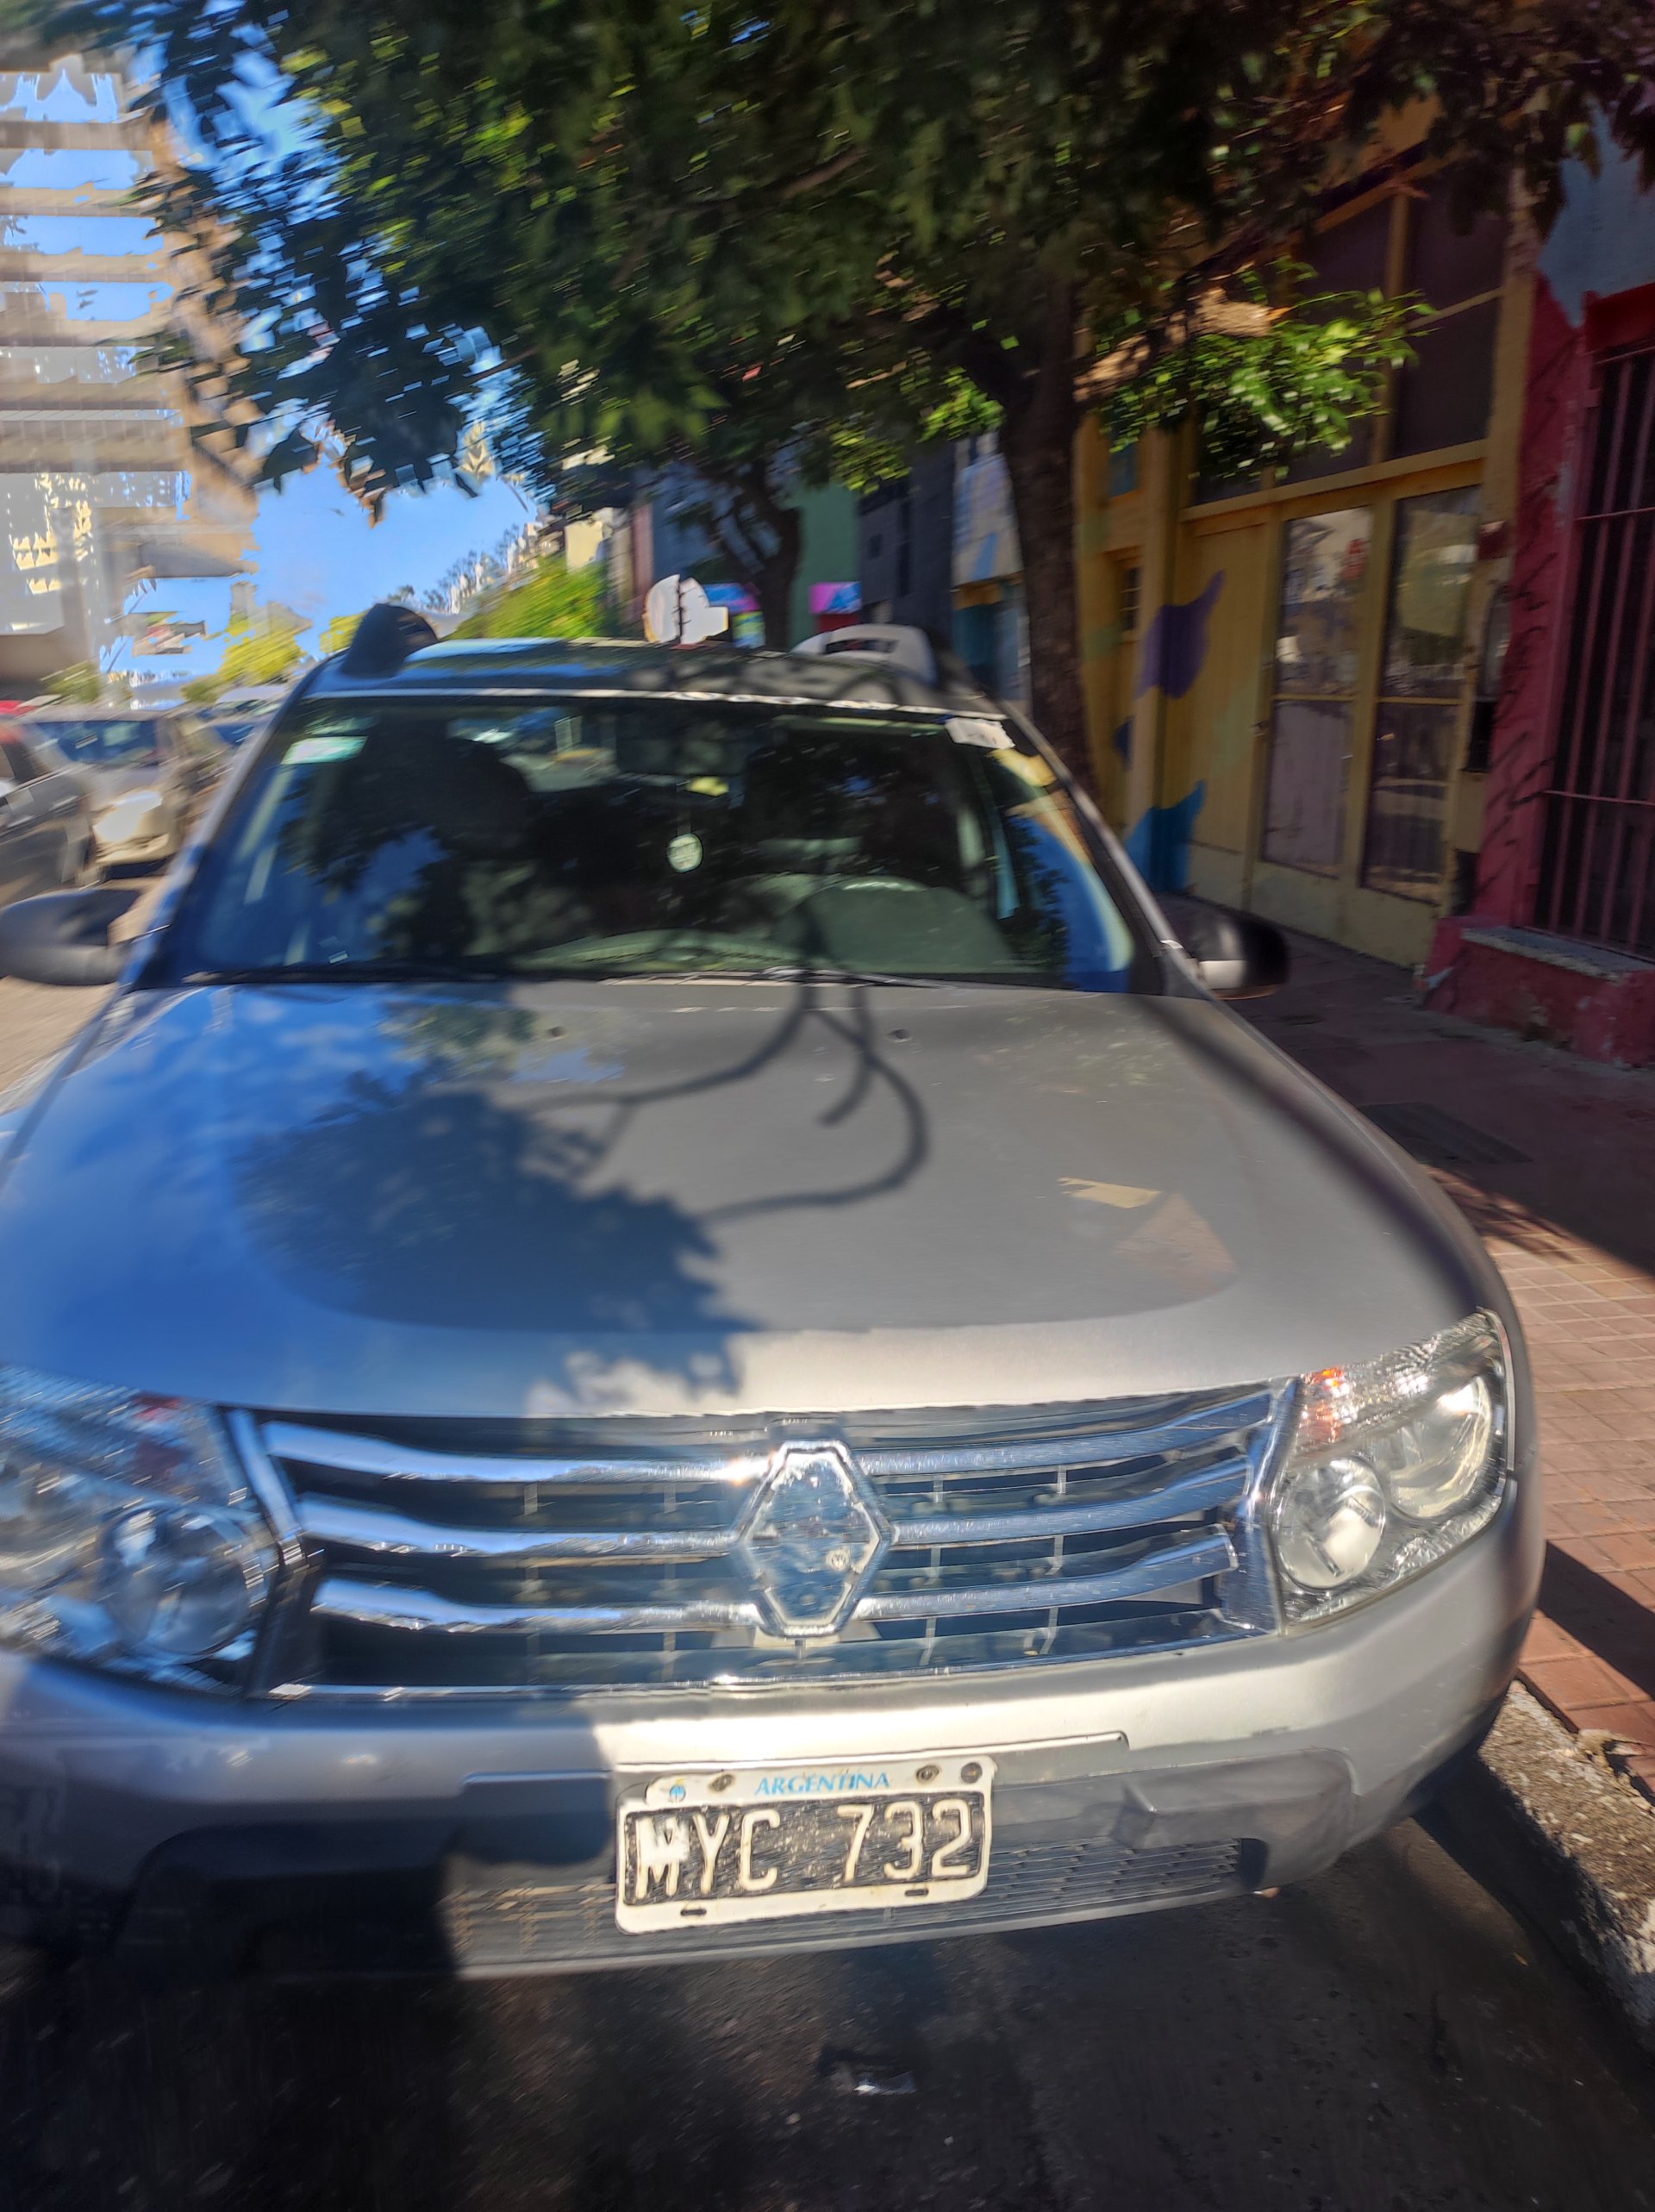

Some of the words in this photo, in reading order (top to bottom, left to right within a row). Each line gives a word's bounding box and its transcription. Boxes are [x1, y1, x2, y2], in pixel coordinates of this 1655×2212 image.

[754, 1771, 890, 1796] ARGENTINA
[634, 1809, 781, 1898] MYC
[836, 1800, 972, 1883] 732
